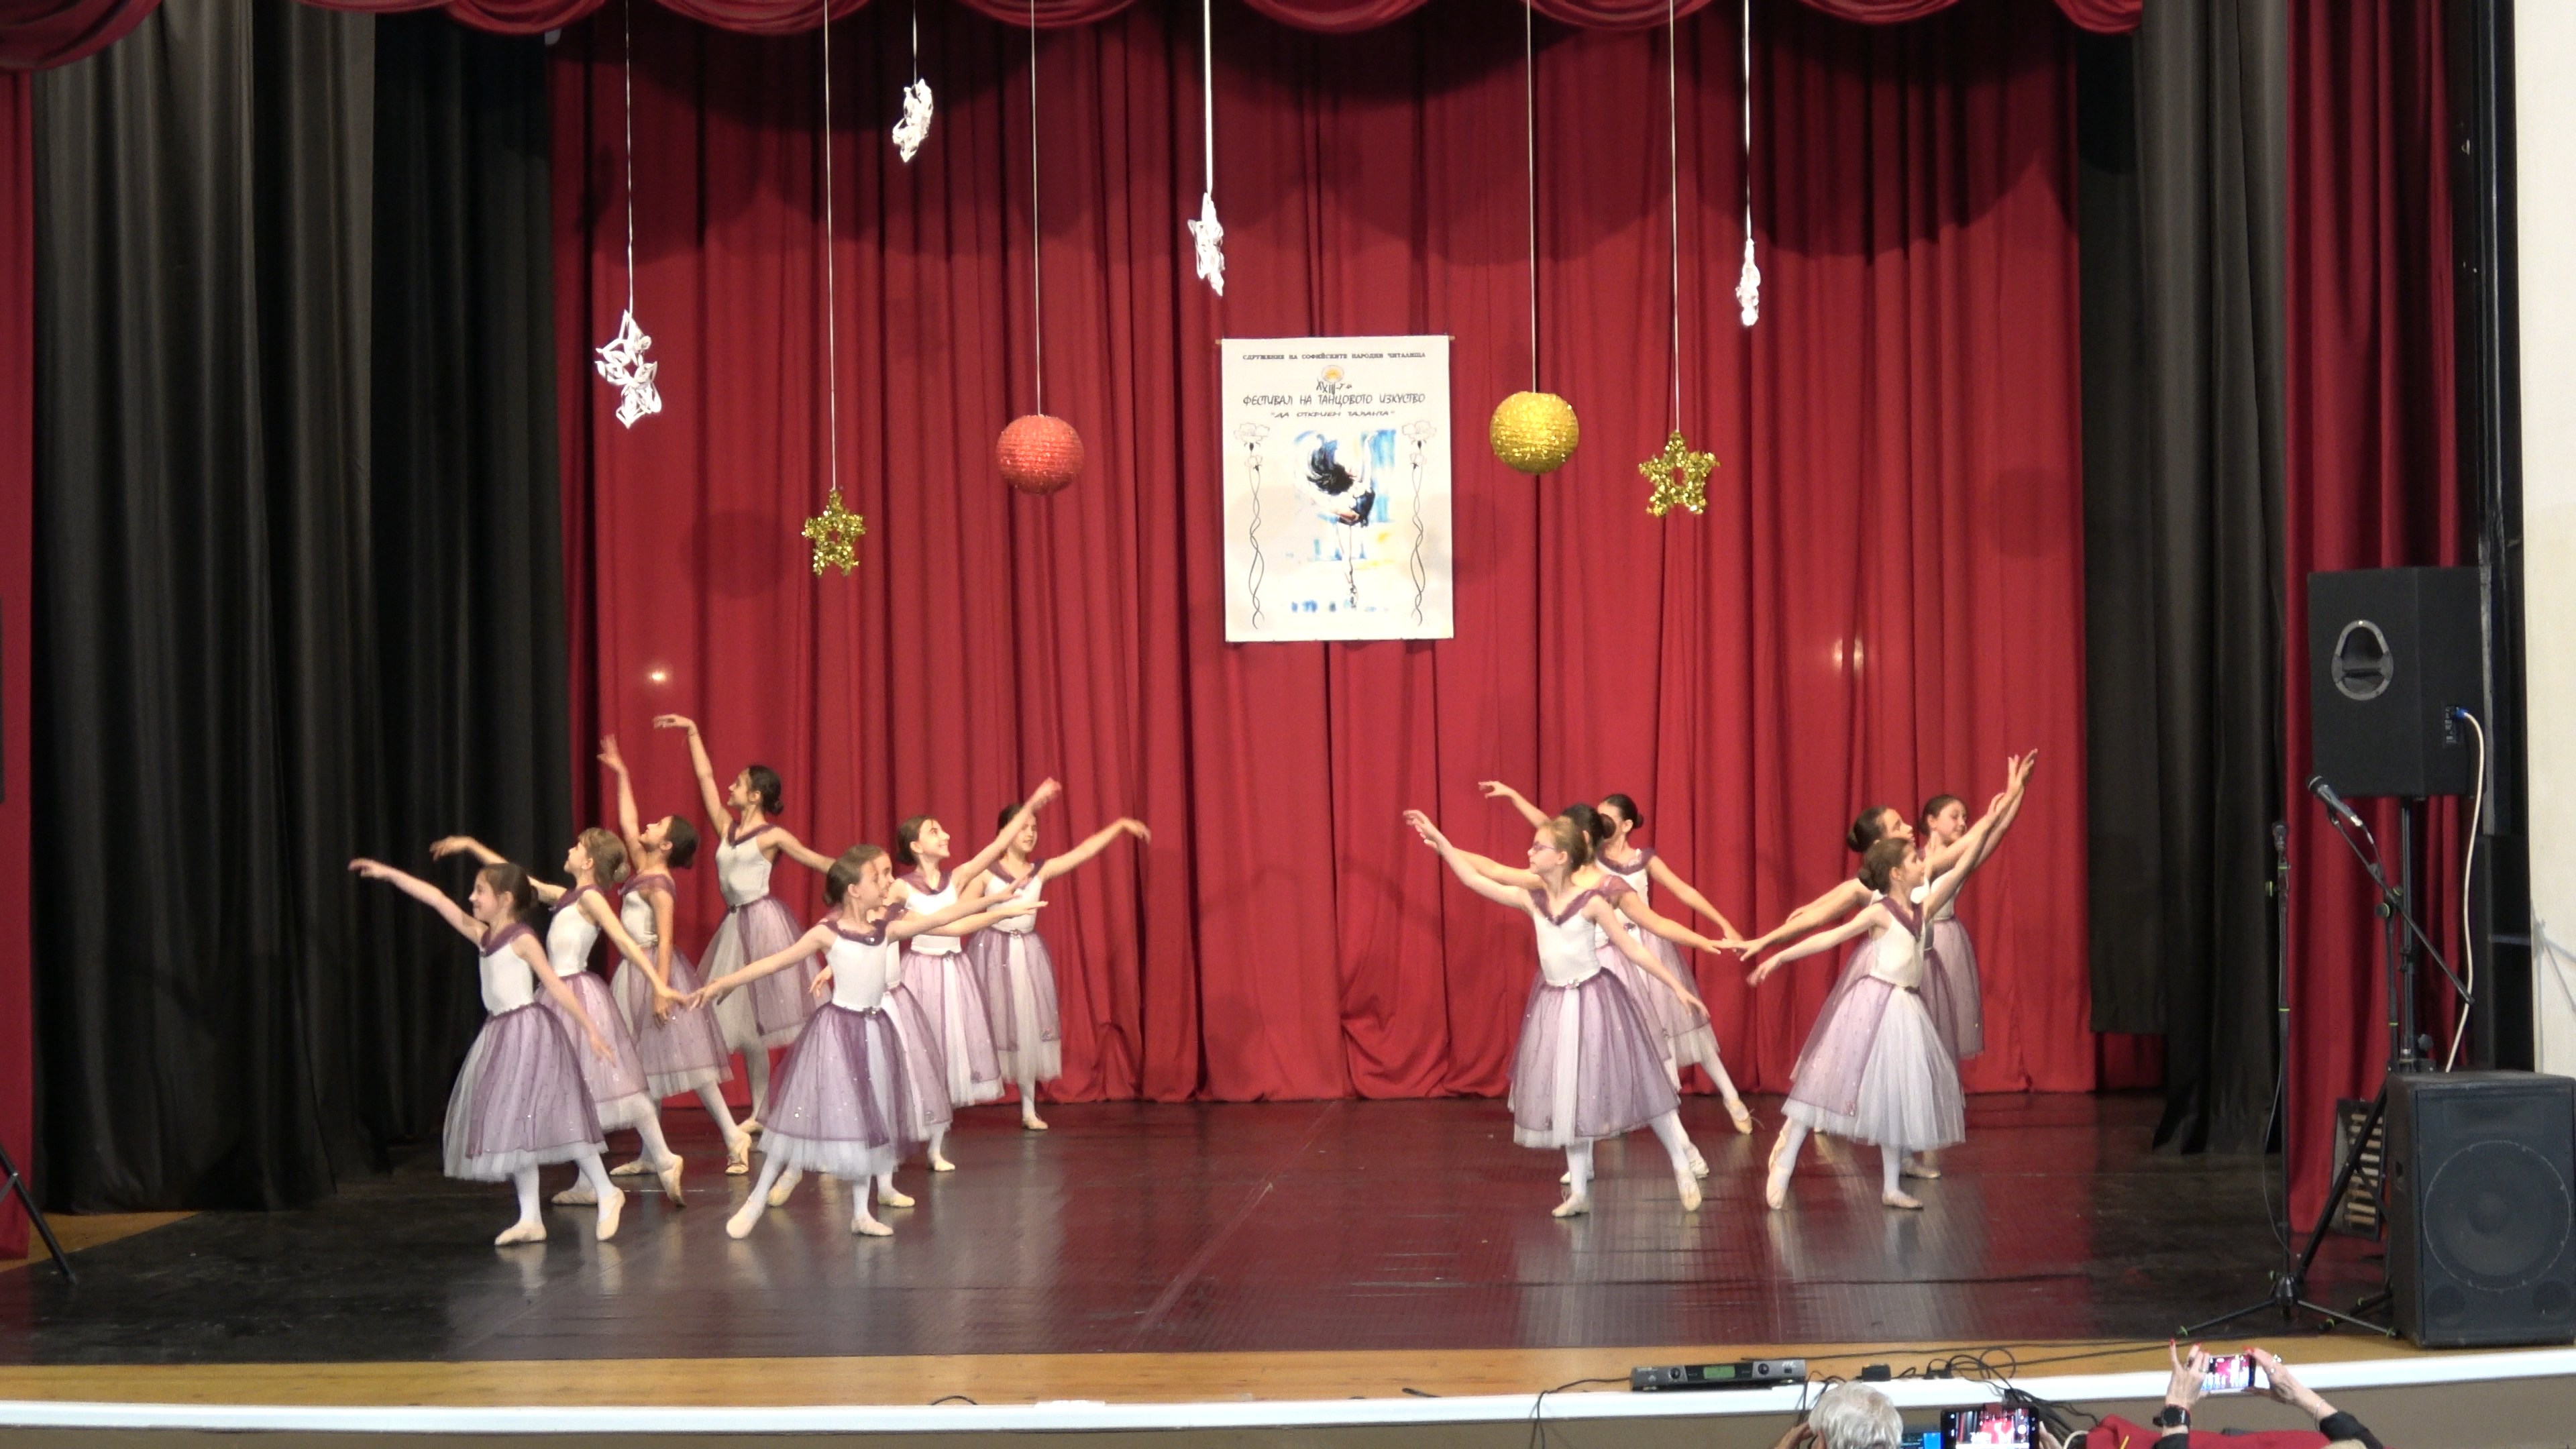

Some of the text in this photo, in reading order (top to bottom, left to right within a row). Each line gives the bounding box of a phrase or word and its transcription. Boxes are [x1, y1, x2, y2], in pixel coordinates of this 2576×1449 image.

[1243, 393, 1426, 409] ФЕСТИВАЛ НА ТАНЦОВОТО ИЗКУСТВО
